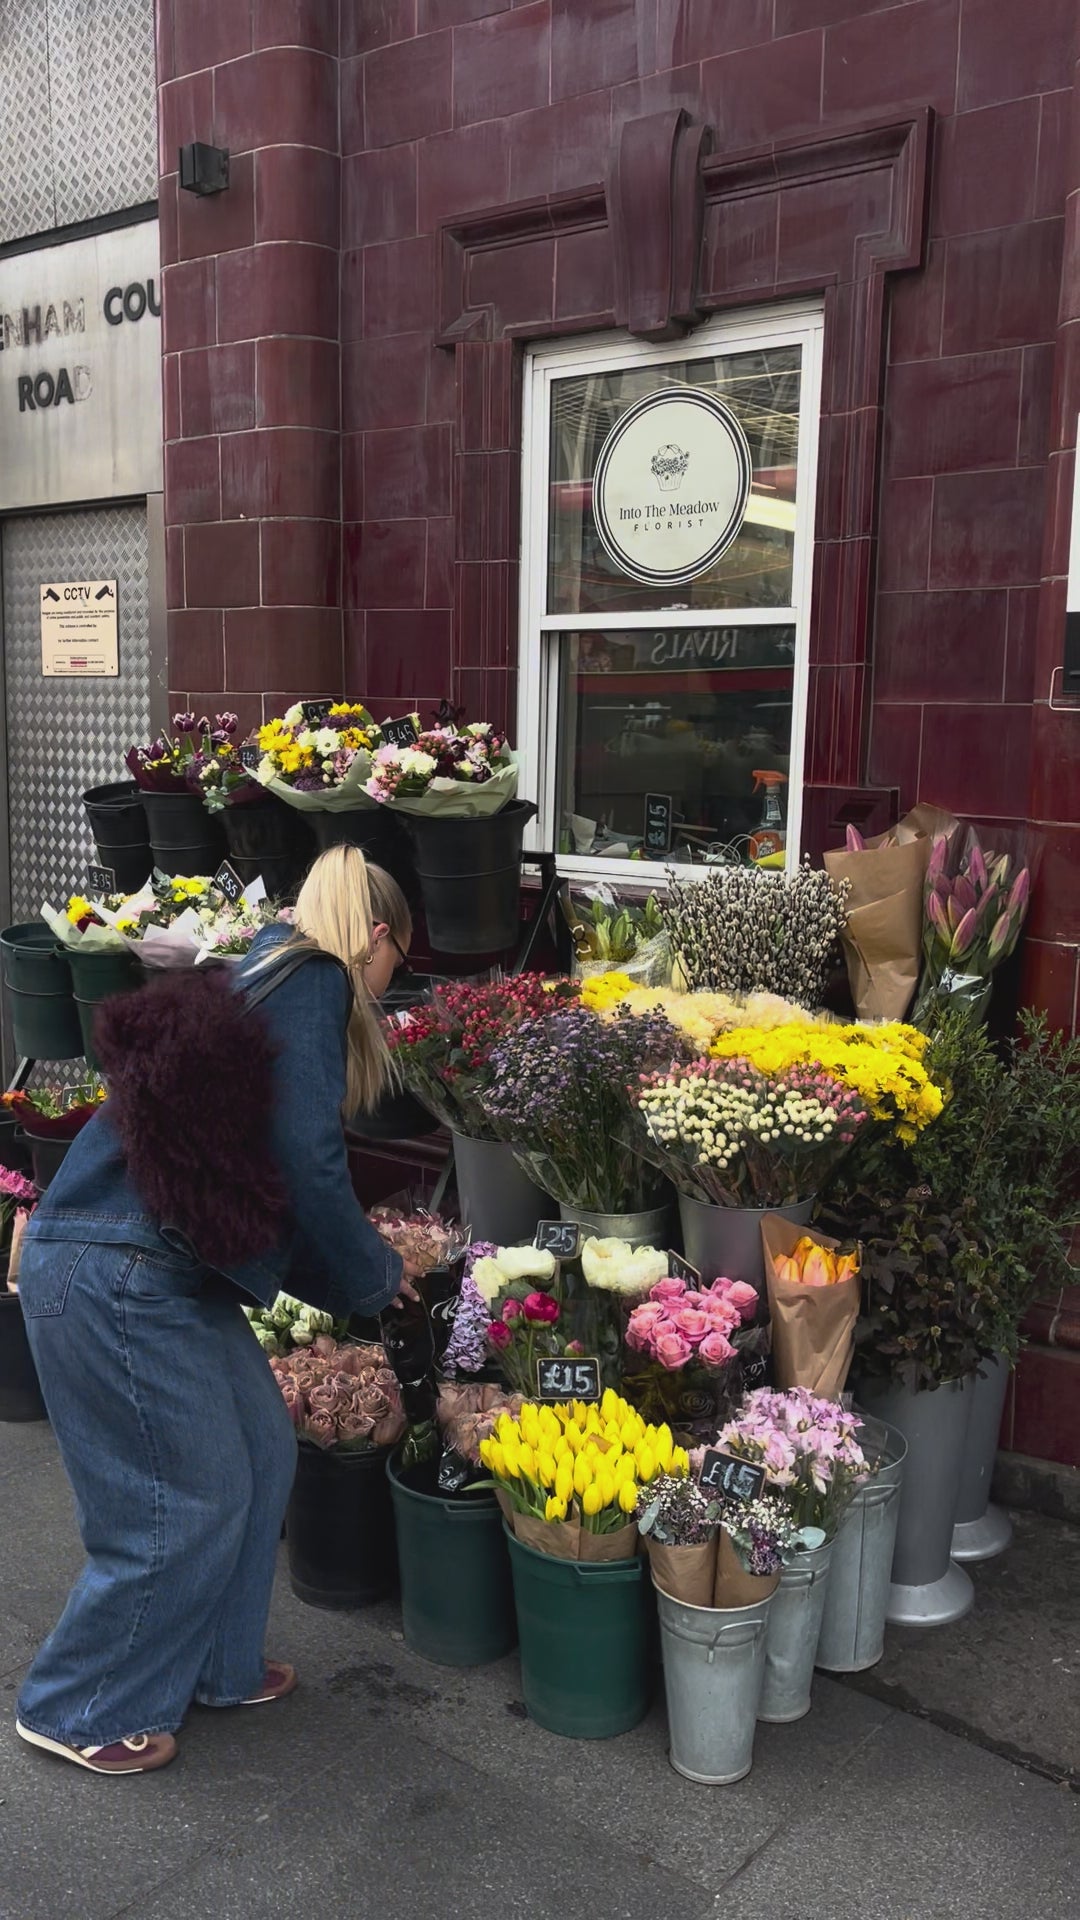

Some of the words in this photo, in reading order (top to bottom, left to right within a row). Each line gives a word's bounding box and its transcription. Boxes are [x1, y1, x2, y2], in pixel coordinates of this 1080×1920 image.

[0, 298, 85, 350] NHAM
[18, 365, 93, 412] ROAD
[619, 507, 641, 520] Into
[645, 504, 666, 518] The
[669, 500, 719, 516] Meadow
[634, 519, 703, 531] FLORIST
[64, 587, 91, 600] CCTV
[388, 724, 416, 745] £45
[92, 871, 111, 890] £35
[217, 872, 238, 898] £55
[542, 1363, 595, 1393] £15
[702, 1461, 760, 1497] £15
